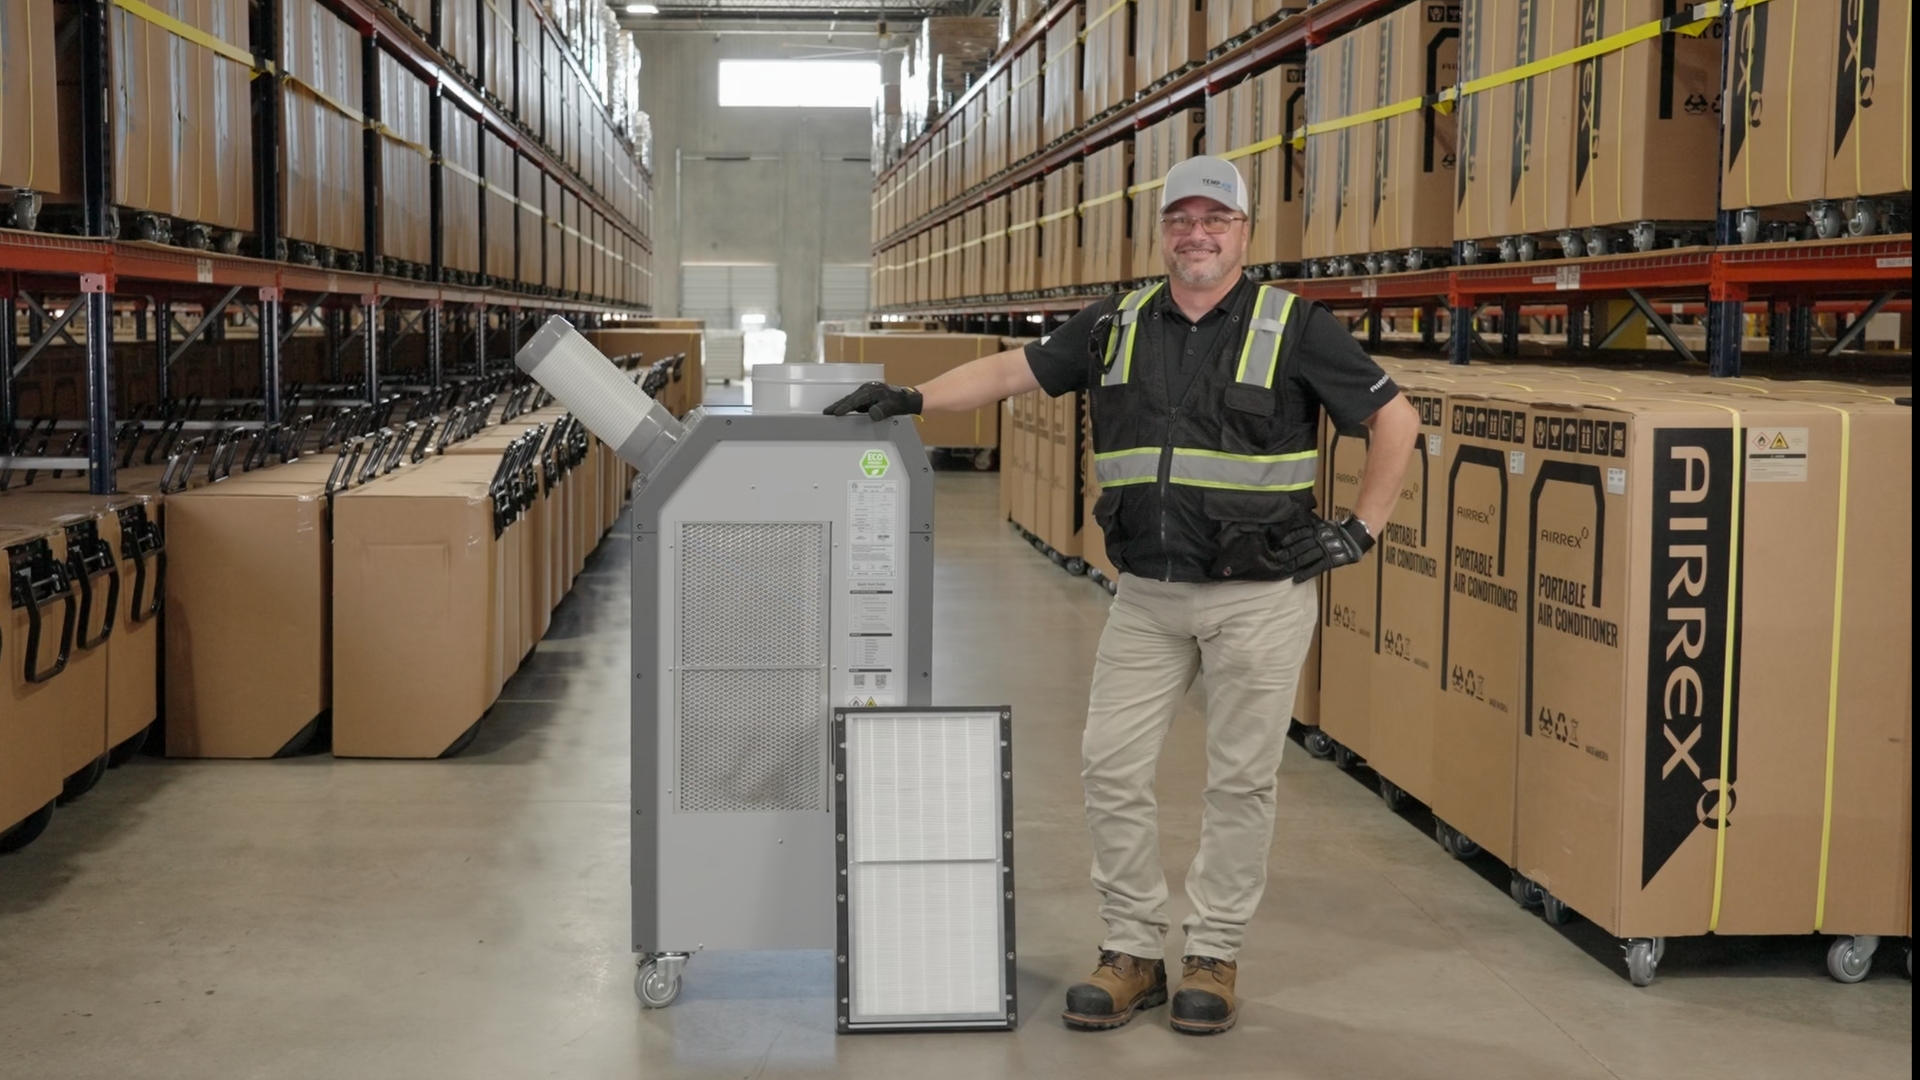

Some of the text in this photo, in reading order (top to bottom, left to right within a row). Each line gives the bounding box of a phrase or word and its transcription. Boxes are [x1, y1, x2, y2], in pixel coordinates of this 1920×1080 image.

[867, 453, 883, 461] ECO
[1457, 506, 1490, 525] AIRREX
[1386, 522, 1418, 549] PORTABLE
[1540, 529, 1582, 549] AIRREX
[1384, 545, 1437, 579] AIR CONDITIONER
[1454, 545, 1493, 578] PORTABLE
[1453, 571, 1518, 613] AIR CONDITIONER
[1539, 573, 1586, 609] PORTABLE
[1538, 602, 1618, 648] AIR CONDITIONER
[1662, 446, 1711, 781] AIRREX
